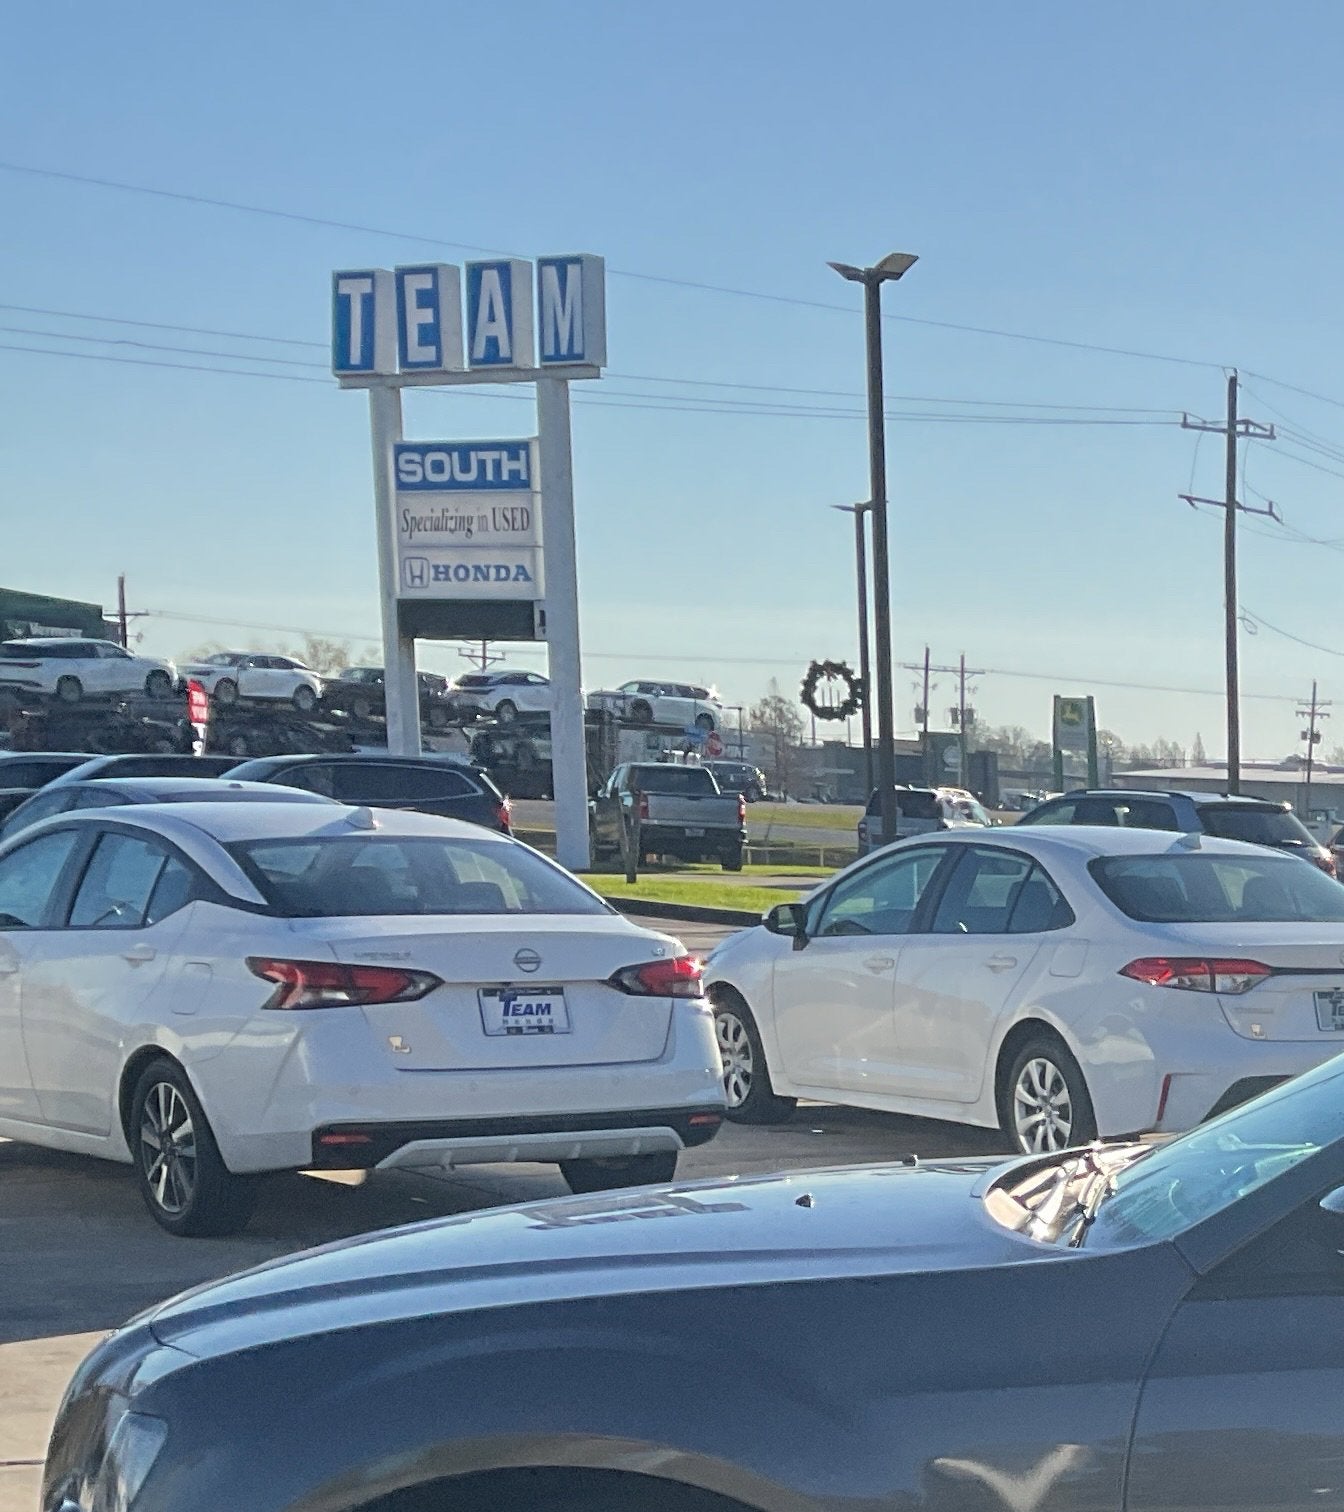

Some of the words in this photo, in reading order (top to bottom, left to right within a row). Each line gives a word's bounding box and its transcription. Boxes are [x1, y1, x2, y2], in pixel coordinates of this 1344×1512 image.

[338, 265, 584, 365] TEAM
[398, 450, 528, 482] SOUTH
[401, 508, 474, 539] Specializing
[477, 508, 489, 532] in
[492, 507, 530, 531] USED
[432, 564, 533, 582] HONDA
[499, 990, 551, 1016] TEAM
